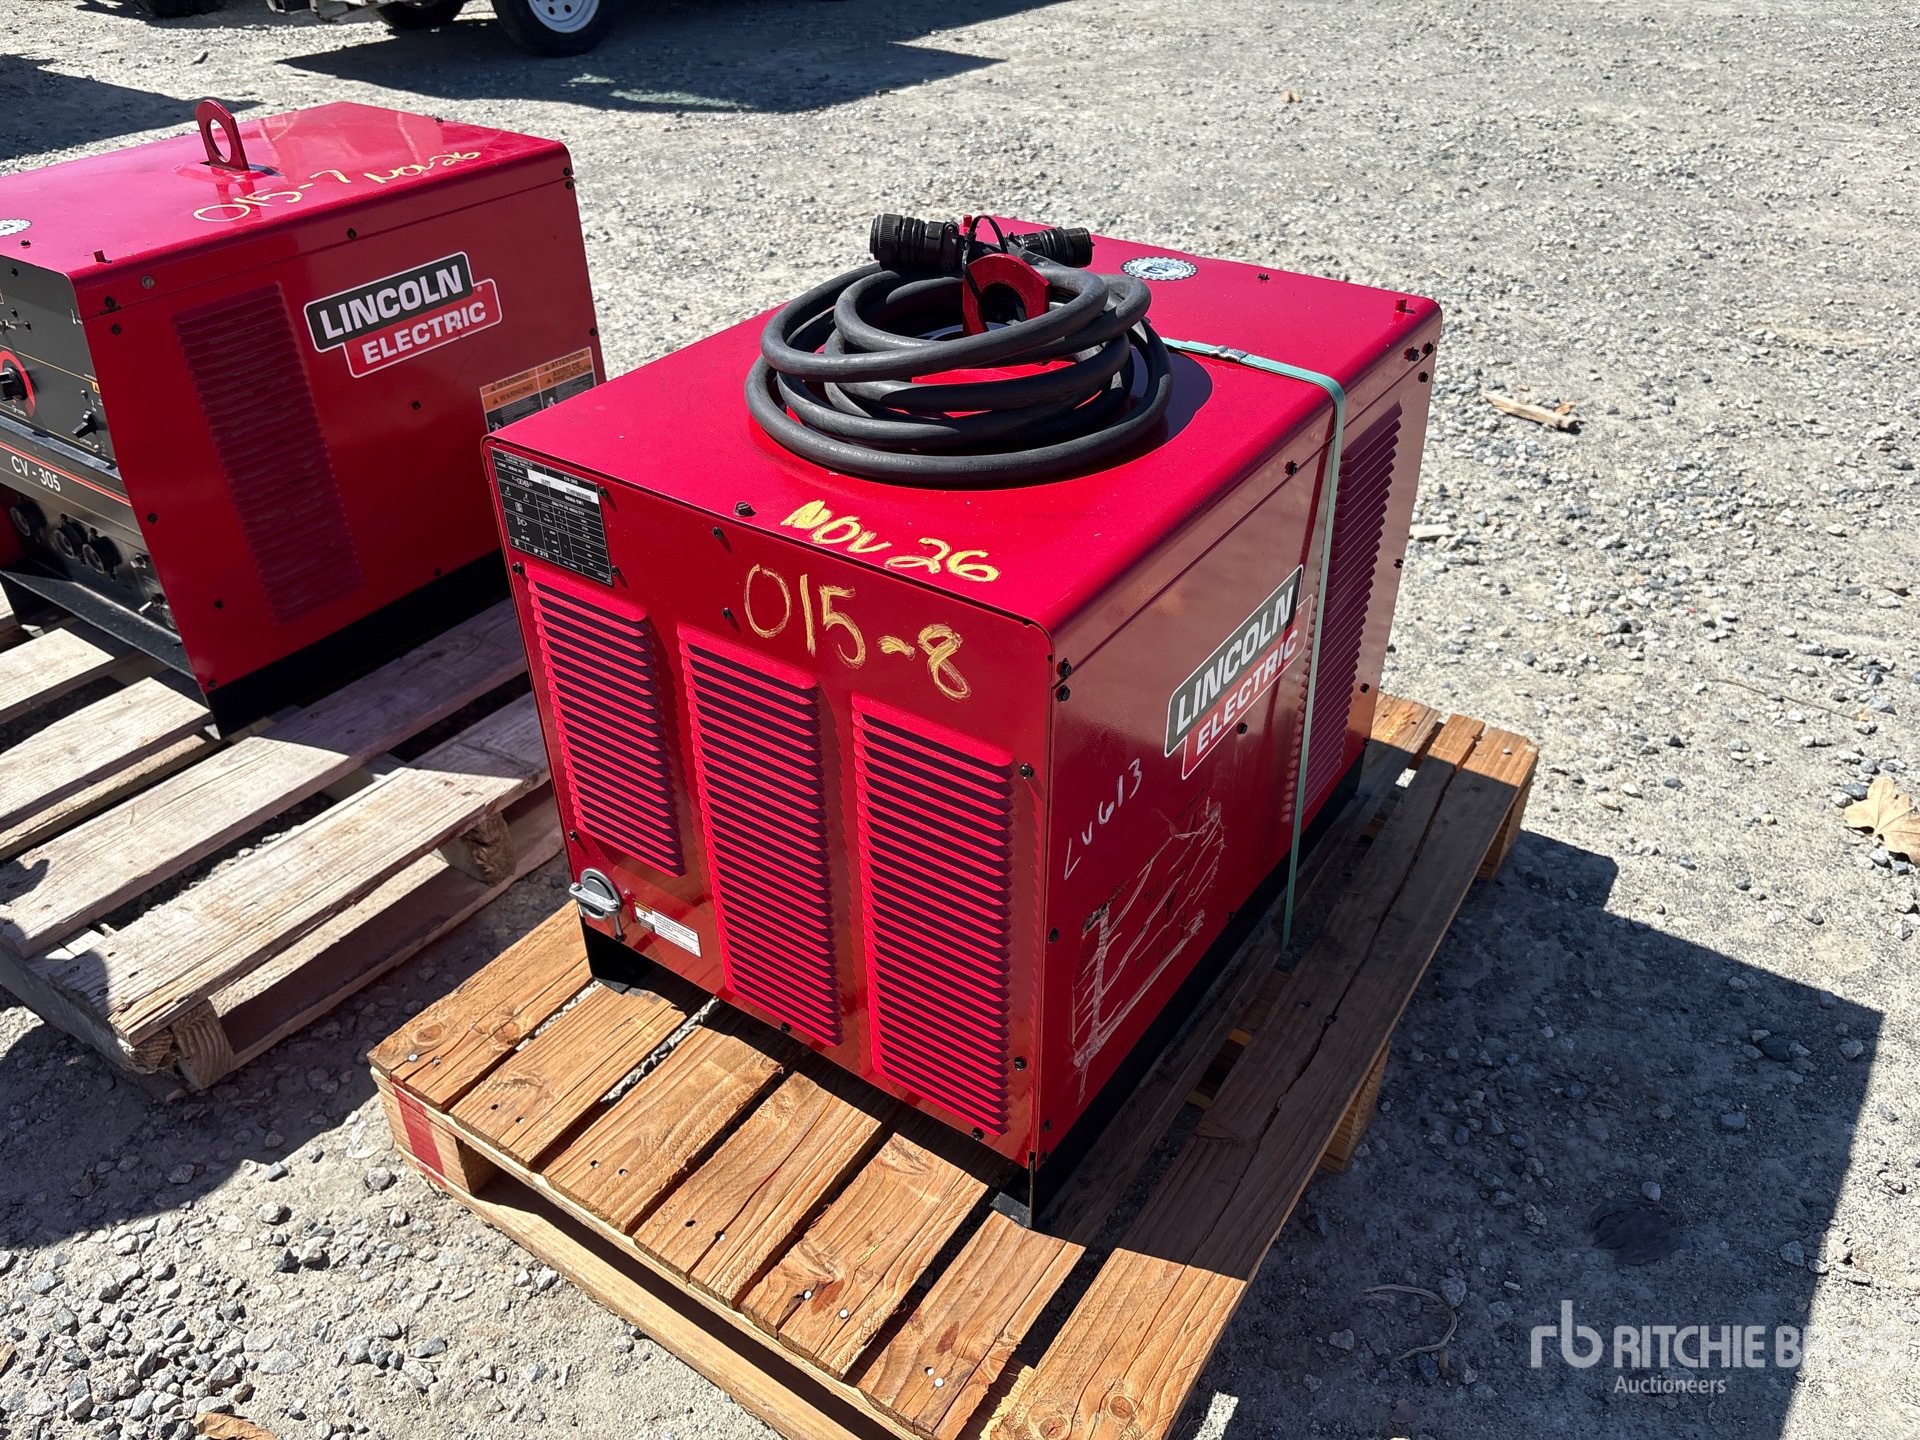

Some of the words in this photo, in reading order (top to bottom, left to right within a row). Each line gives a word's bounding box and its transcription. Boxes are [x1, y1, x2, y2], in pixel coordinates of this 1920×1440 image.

[193, 169, 351, 222] 015-7
[319, 264, 464, 340] LINCOLN
[361, 301, 487, 365] ELECTRIC
[496, 372, 530, 388] WARNING
[499, 384, 535, 402] WARNUNG
[11, 455, 28, 477] CV
[38, 467, 61, 492] 305
[780, 499, 892, 553] NOV
[884, 537, 1000, 583] 26
[743, 563, 971, 702] 015-8
[1176, 584, 1294, 736] LINCOLN
[1196, 629, 1298, 757] ELECTRIC
